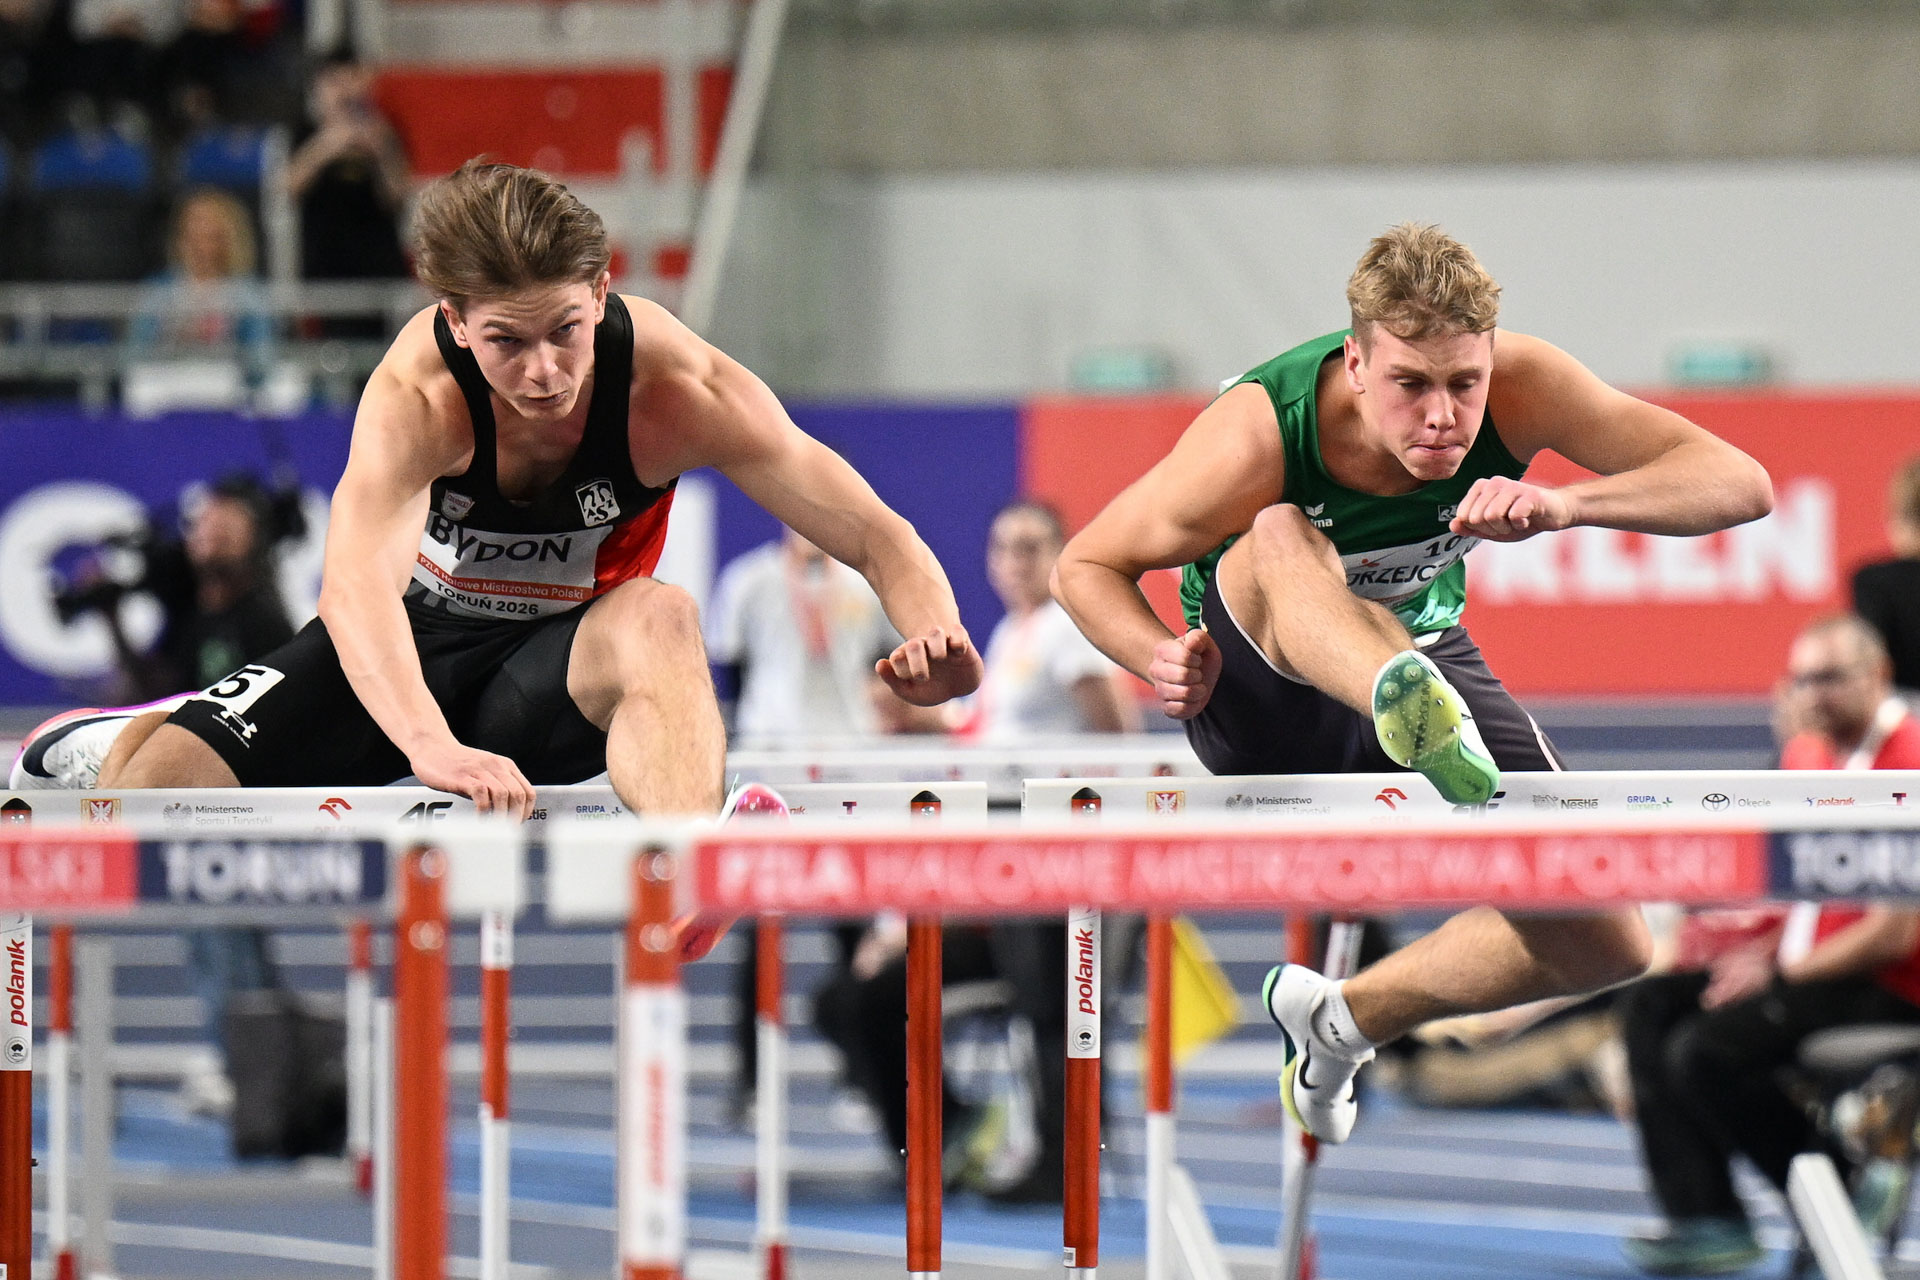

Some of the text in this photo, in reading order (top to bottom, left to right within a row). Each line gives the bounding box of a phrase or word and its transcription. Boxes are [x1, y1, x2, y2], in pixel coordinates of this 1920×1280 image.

[429, 515, 572, 563] BYDOŃ
[419, 556, 584, 600] PZLA Halowe Mistrzostwa Polski
[436, 581, 491, 610] TORUŃ
[496, 600, 539, 615] 2026
[209, 668, 266, 698] 5
[195, 805, 254, 814] Ministerstwo
[576, 805, 606, 813] GRUPA
[1256, 796, 1312, 805] Ministerstwo
[1627, 796, 1656, 804] GRUPA
[1817, 797, 1855, 808] polanik
[6, 938, 28, 1027] polanik
[1074, 928, 1096, 1015] polanik
